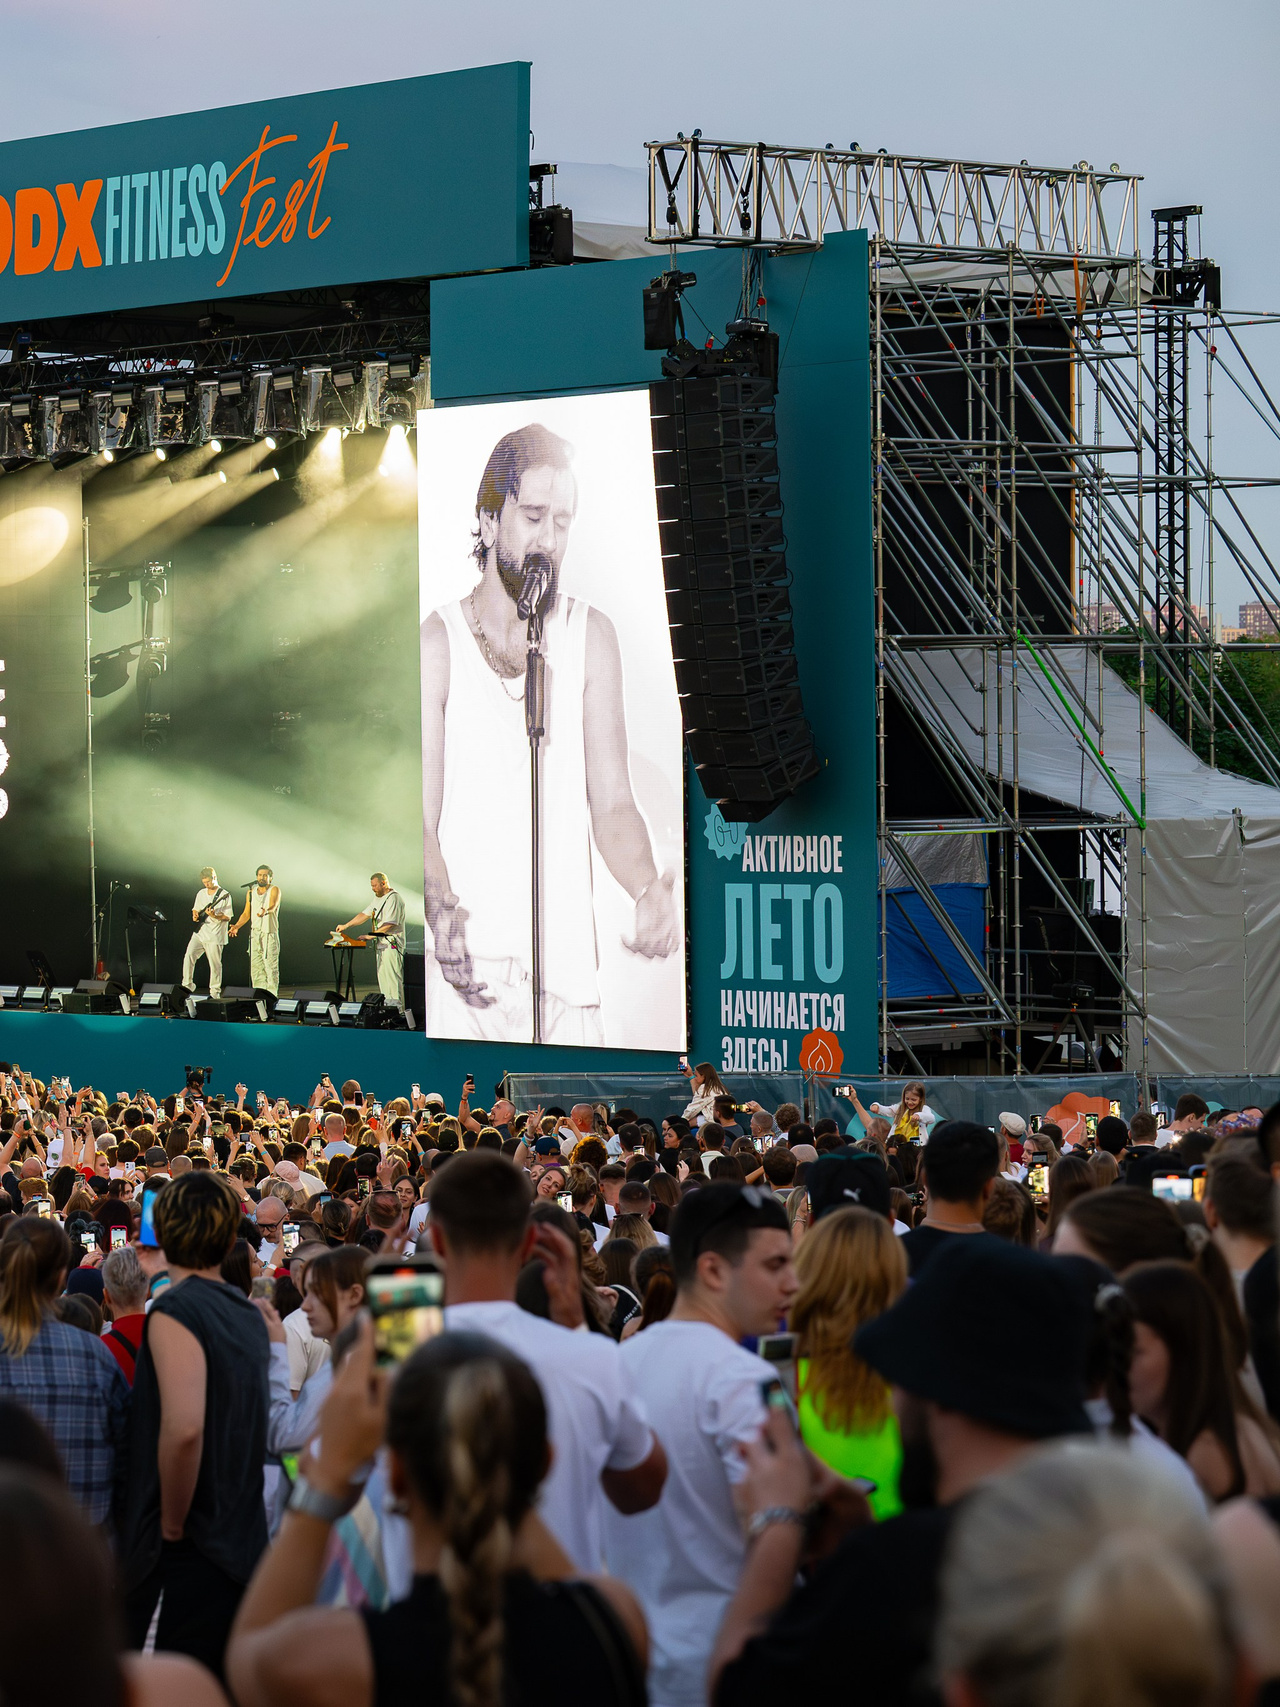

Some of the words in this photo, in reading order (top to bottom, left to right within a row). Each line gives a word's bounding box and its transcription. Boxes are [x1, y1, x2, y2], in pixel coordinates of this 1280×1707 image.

[105, 160, 228, 266] FITNESS
[216, 120, 349, 288] Fest
[742, 835, 843, 873] АКТИВНОЕ
[720, 882, 844, 984] ЛЕТО
[720, 989, 845, 1032] НАЧИНАЕТСЯ
[721, 1036, 788, 1076] ЗДЕСЬ!
